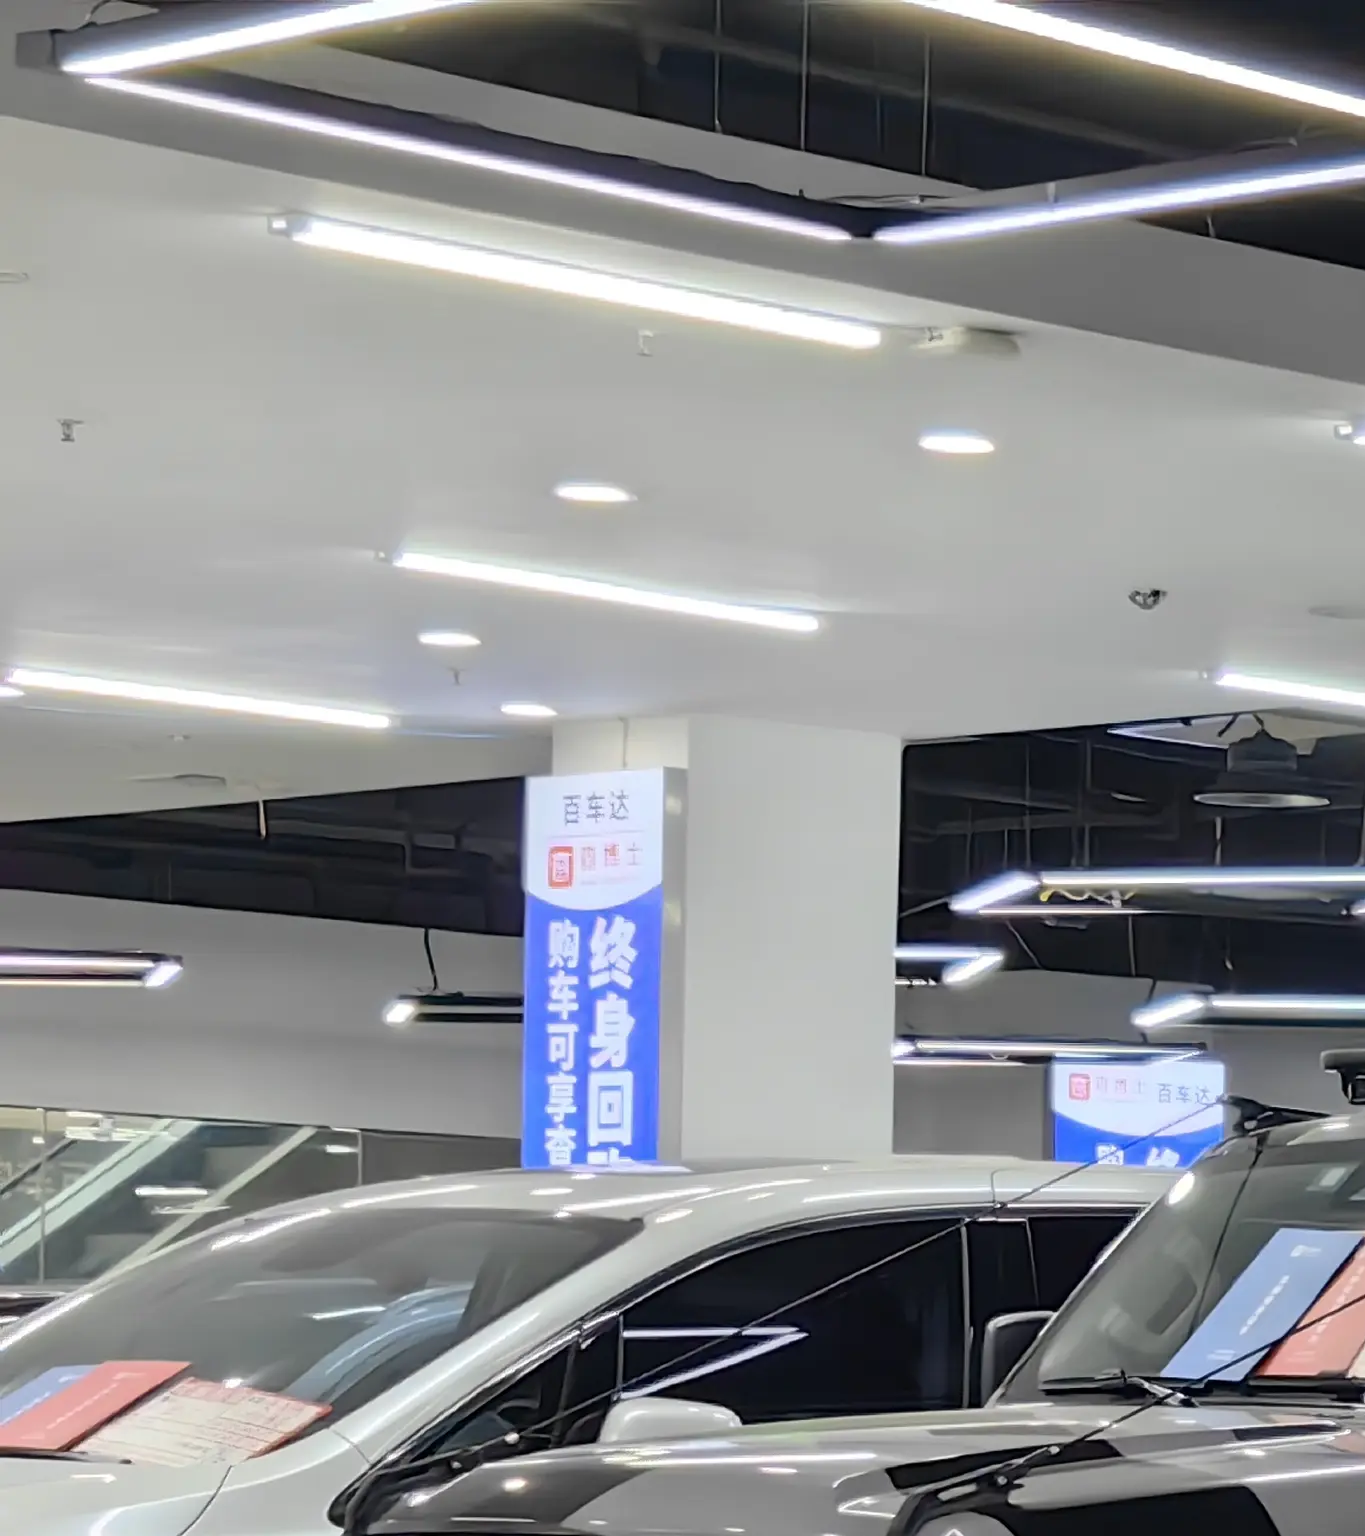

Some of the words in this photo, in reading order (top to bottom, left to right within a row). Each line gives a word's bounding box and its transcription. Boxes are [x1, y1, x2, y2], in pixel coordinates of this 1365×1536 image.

[563, 789, 630, 827] 百车达
[587, 914, 639, 1167] 终身回
[1157, 1082, 1213, 1106] 百车达
